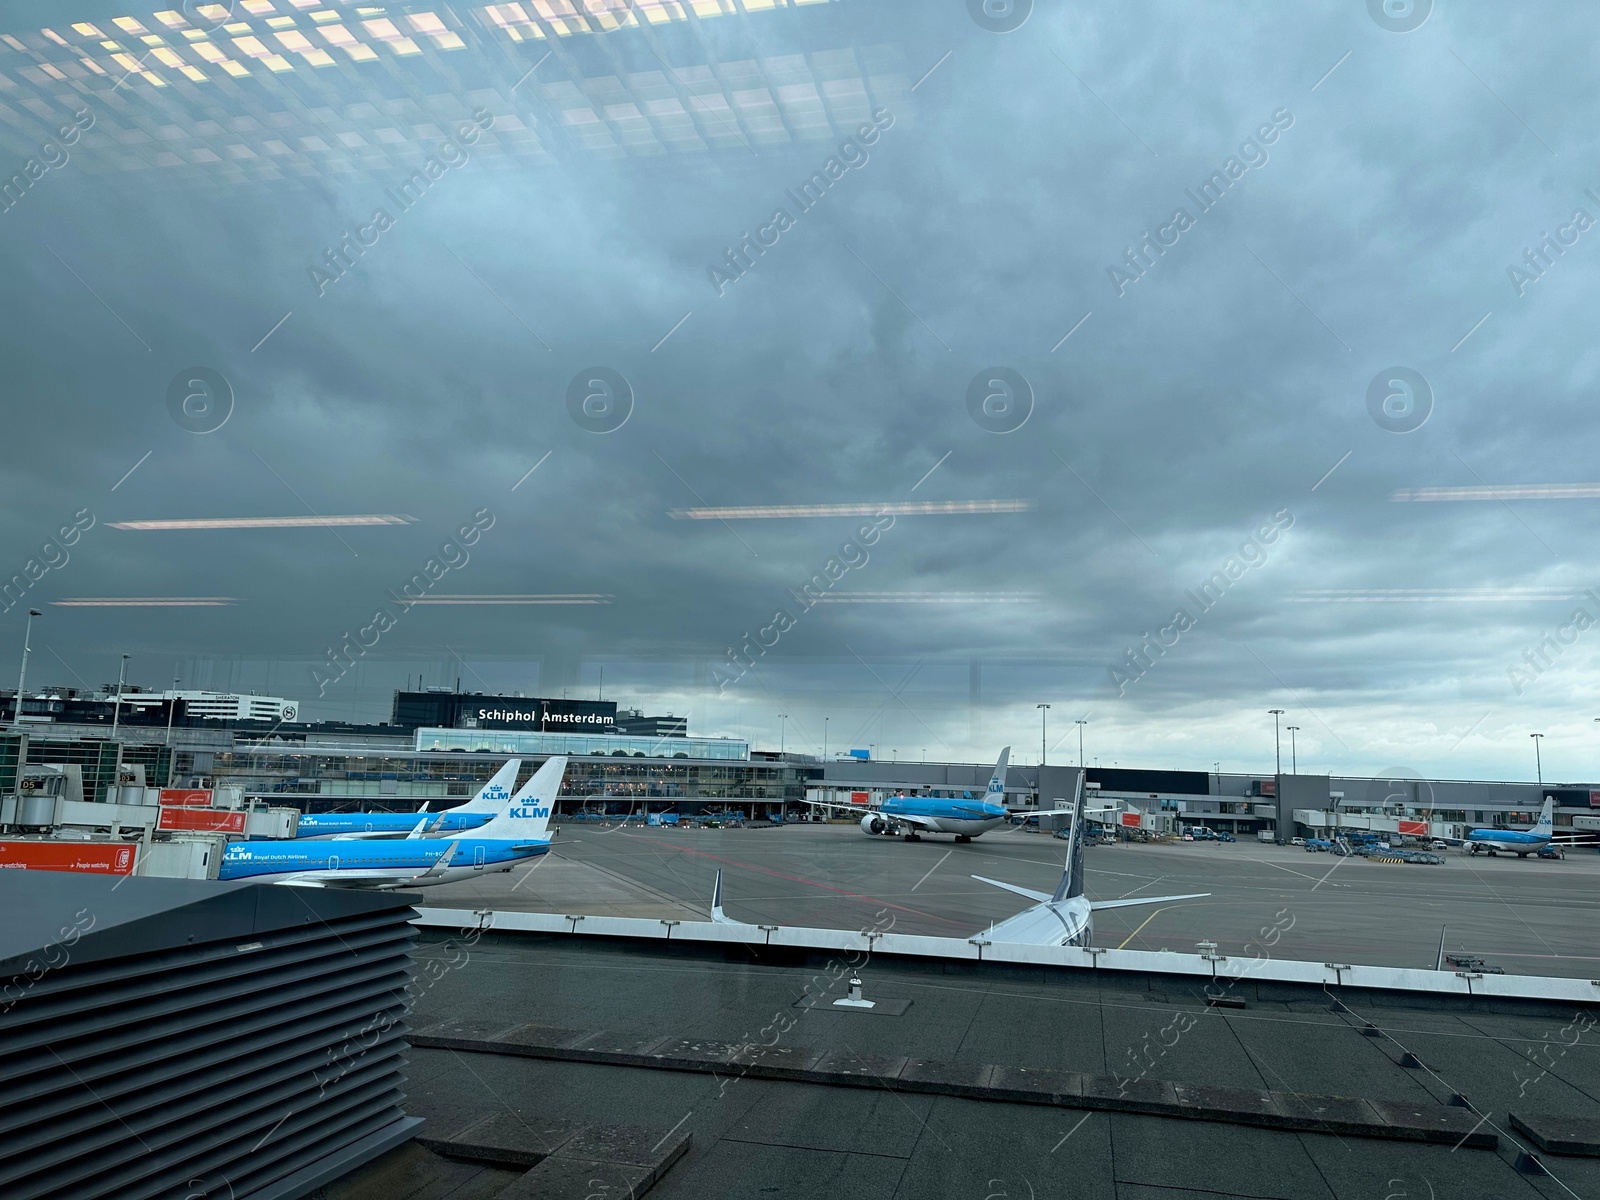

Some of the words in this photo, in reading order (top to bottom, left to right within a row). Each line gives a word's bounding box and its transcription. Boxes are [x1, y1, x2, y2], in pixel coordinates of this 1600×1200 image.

[478, 709, 535, 723] Schiphol
[541, 712, 614, 724] Amsterdam
[22, 781, 35, 789] D5
[482, 792, 509, 800] KLM
[509, 808, 549, 818] KLM
[222, 852, 252, 860] KLM
